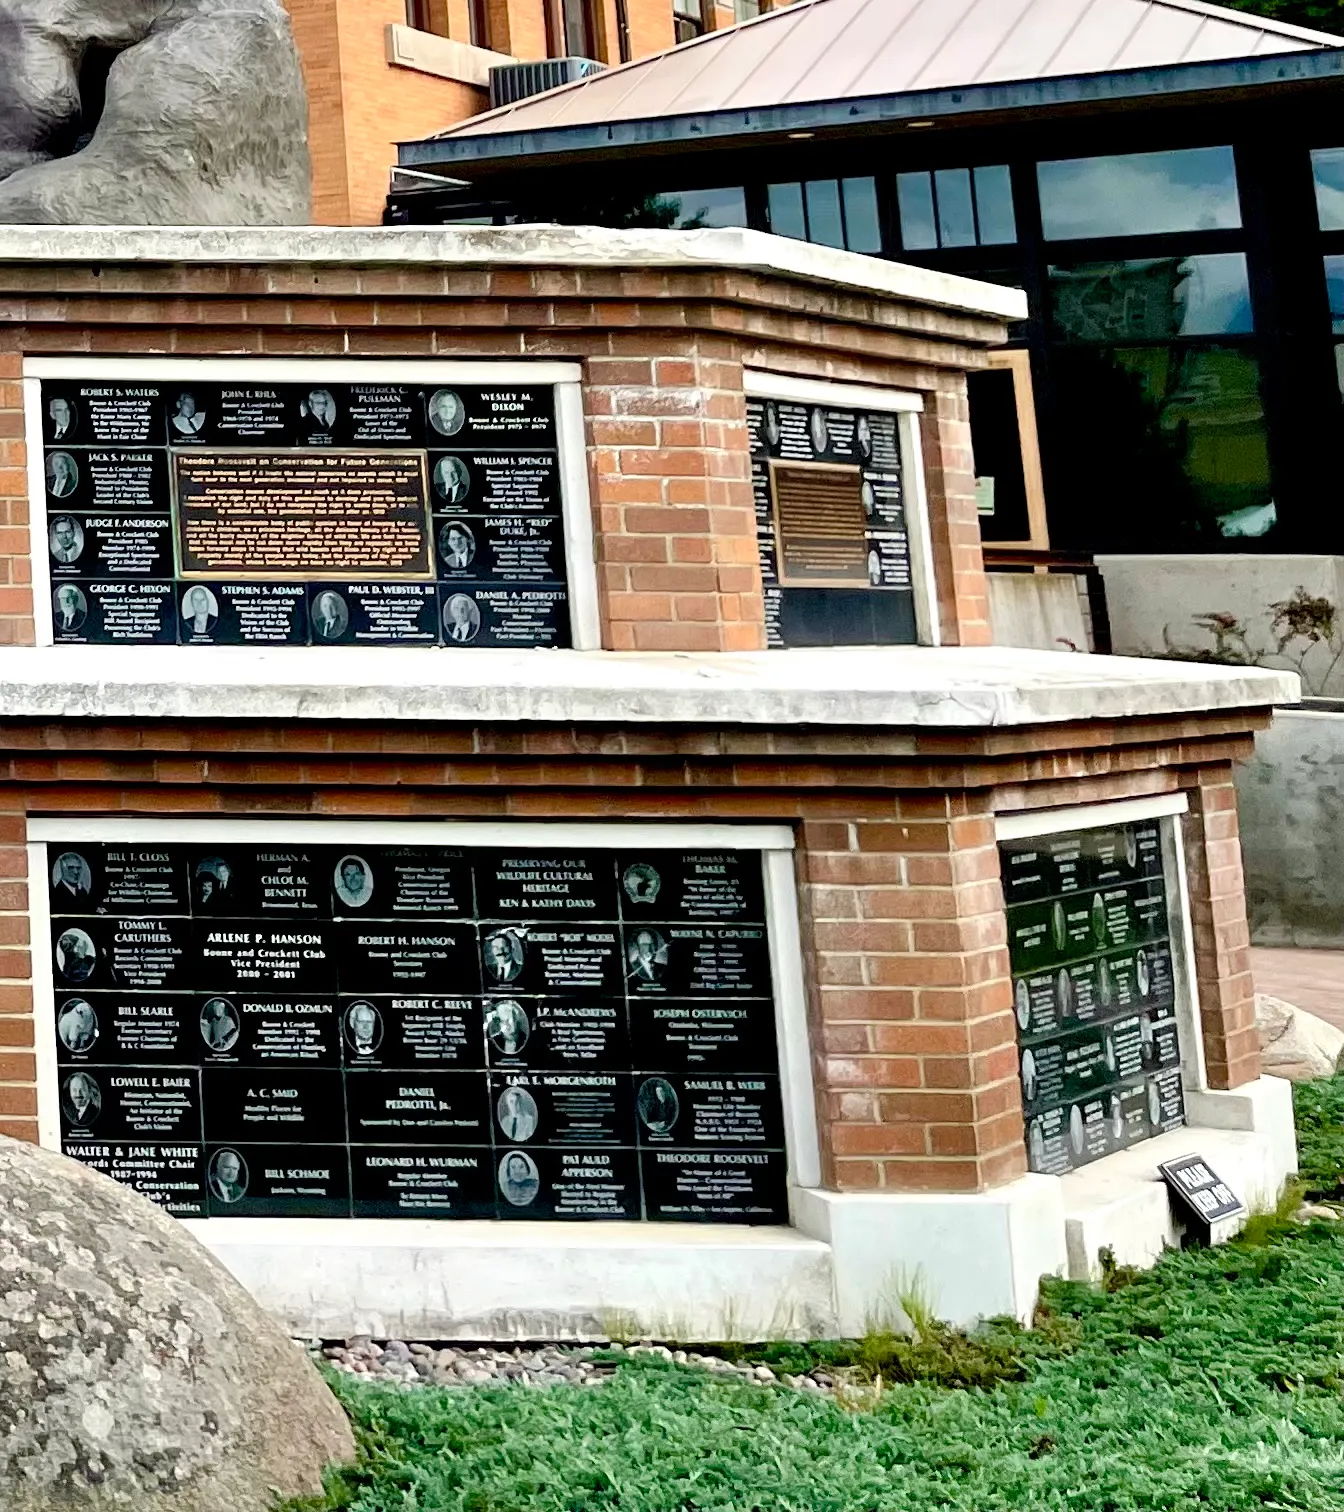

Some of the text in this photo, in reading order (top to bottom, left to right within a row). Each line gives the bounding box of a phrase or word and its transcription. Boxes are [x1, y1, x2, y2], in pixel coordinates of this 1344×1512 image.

[481, 393, 517, 401] WESLEY
[492, 403, 524, 411] DIXON
[89, 453, 109, 462] JACK
[123, 520, 169, 528] ANDERSON
[90, 585, 126, 593] GEORGE
[349, 586, 370, 594] PAUL
[119, 921, 155, 930] TOMMY
[115, 934, 171, 943] CARUTHERS
[207, 933, 321, 945] ARLENE P. HANSON
[412, 937, 455, 946] HANSON
[204, 949, 326, 959] Boone and Crockett Club
[231, 959, 300, 968] Vice President
[243, 1004, 283, 1013] DONALD
[66, 1146, 198, 1157] WALTER & JANE WHITE
[113, 1159, 165, 1168] Committee
[169, 1160, 195, 1168] Chair
[136, 1181, 199, 1190] Conservation
